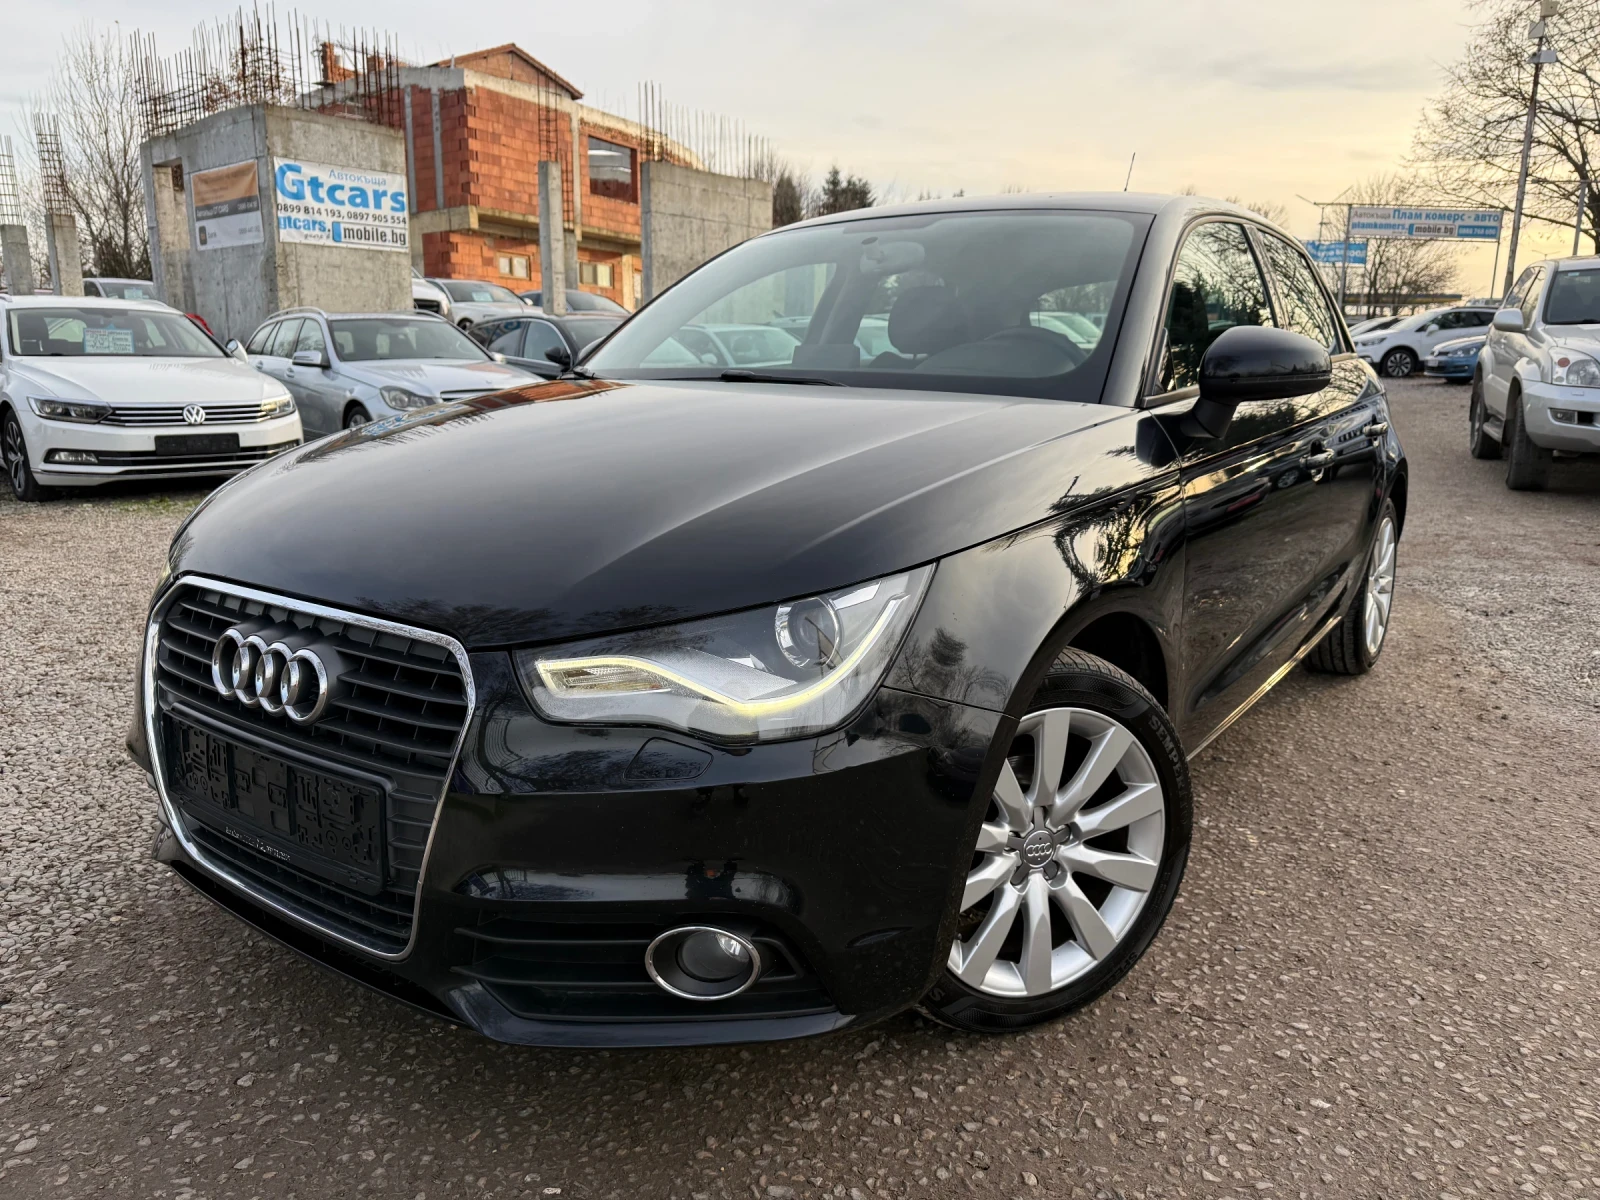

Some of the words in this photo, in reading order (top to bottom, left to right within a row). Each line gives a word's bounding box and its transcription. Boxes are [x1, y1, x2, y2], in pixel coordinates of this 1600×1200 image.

[276, 163, 406, 213] Gtcars
[329, 169, 387, 186] Автокъща
[277, 203, 301, 214] 0899
[303, 206, 322, 217] 814
[324, 208, 345, 220] 193,
[346, 211, 370, 221] 0897
[372, 214, 390, 223] 905
[391, 215, 407, 225] 554
[1353, 211, 1391, 220] Автокъща
[1393, 209, 1423, 220] Плам
[1425, 212, 1466, 223] комерс
[1474, 214, 1500, 222] авто
[182, 403, 206, 425] VW
